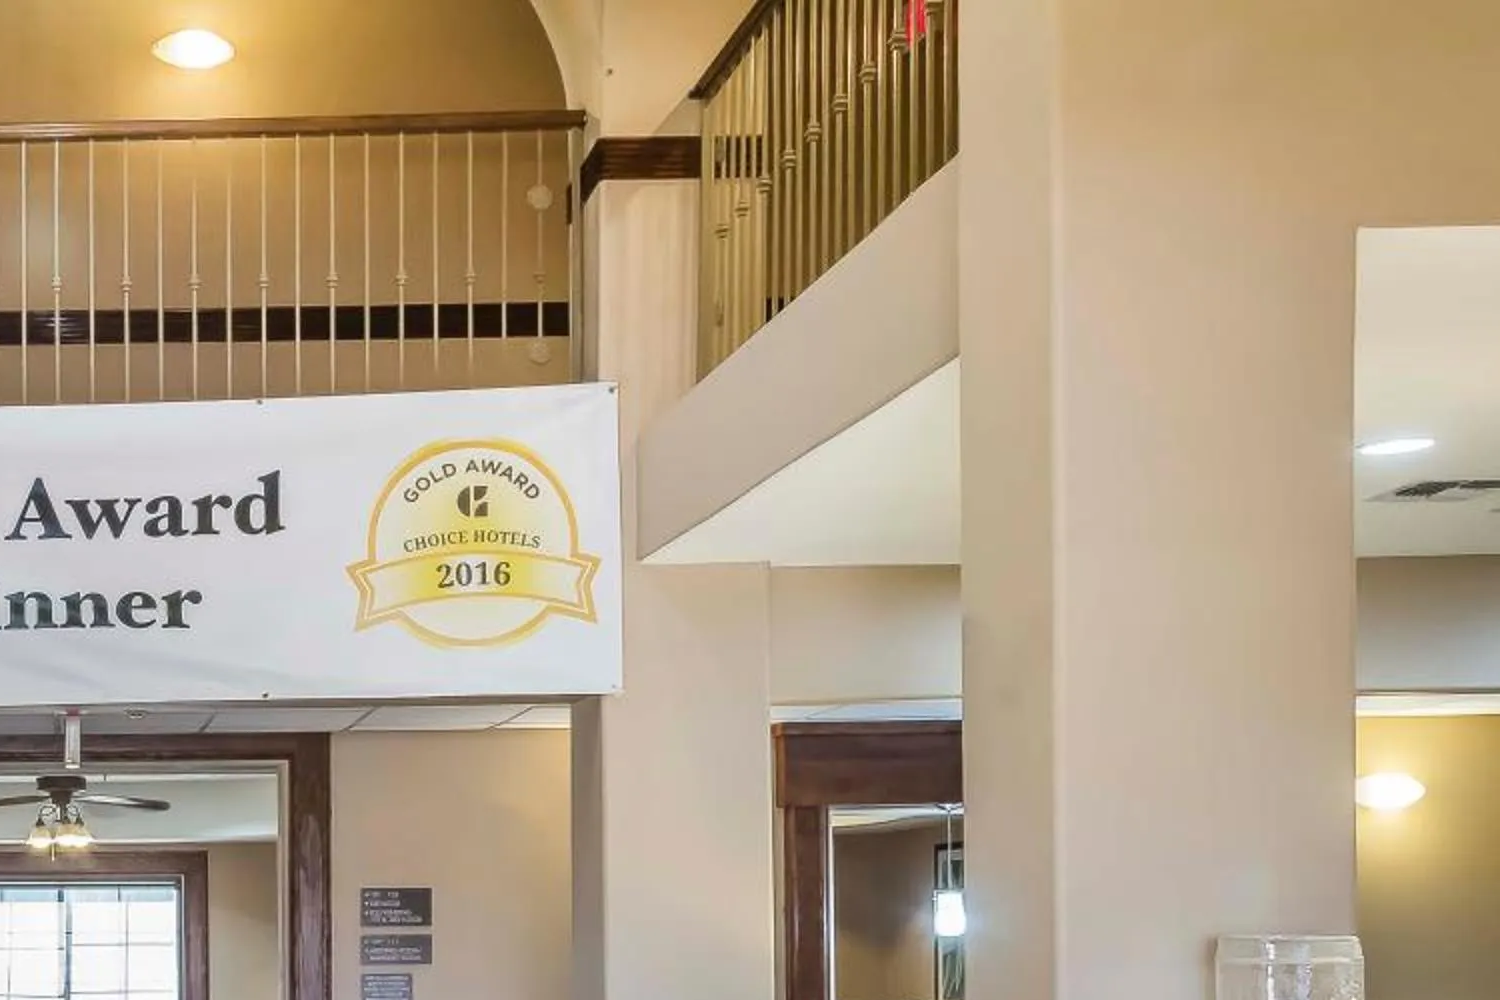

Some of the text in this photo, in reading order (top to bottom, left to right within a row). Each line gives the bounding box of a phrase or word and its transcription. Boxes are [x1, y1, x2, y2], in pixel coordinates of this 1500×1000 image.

[403, 459, 540, 503] GOLD AWARD
[5, 468, 286, 541] Award
[403, 529, 542, 552] CHOICE HOTELS
[436, 561, 511, 589] 2016
